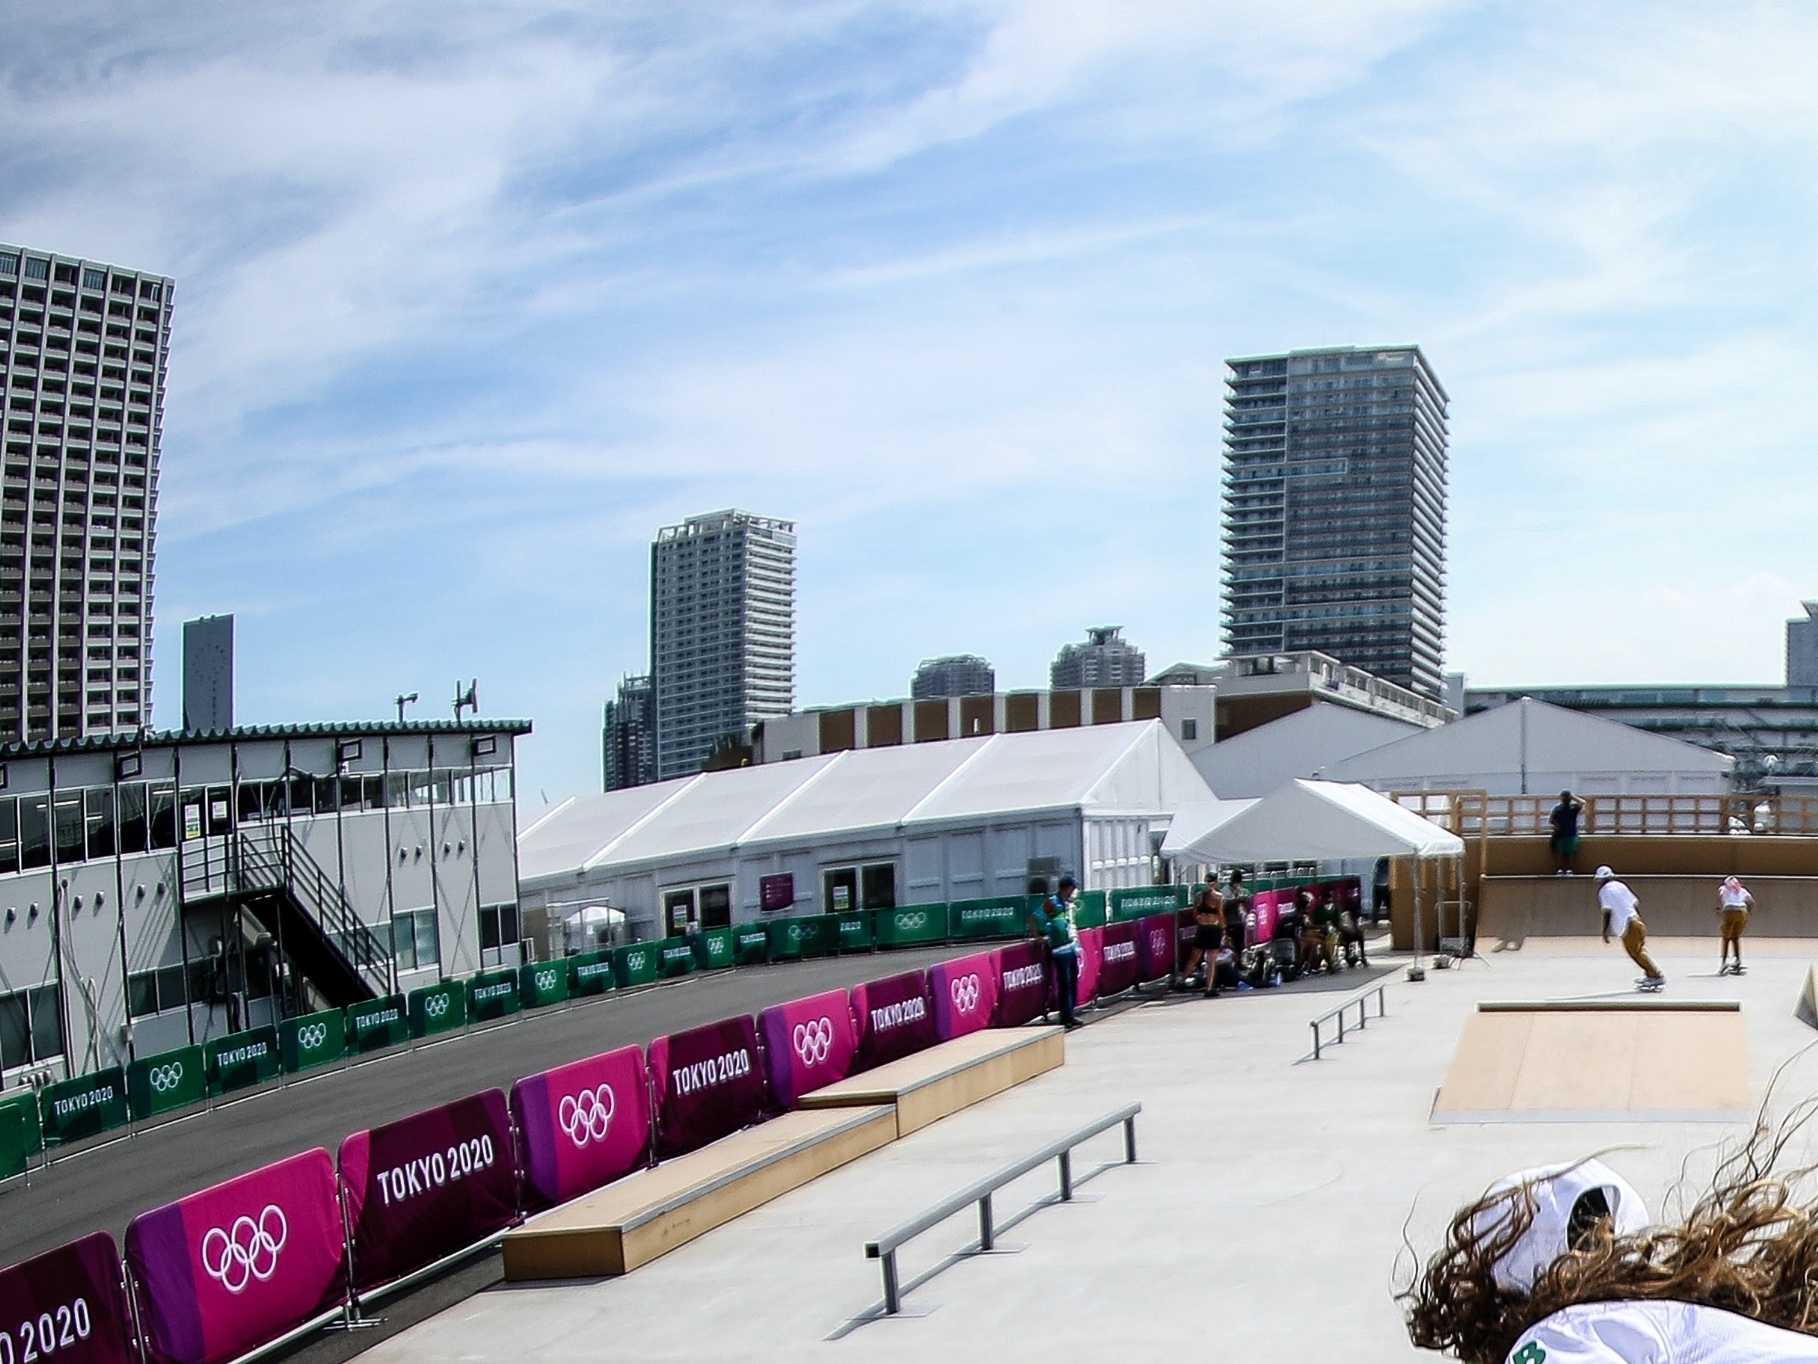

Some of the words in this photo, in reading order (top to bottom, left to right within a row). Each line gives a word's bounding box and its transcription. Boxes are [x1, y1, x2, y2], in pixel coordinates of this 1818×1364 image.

[355, 1012, 379, 1029] TOKYO
[871, 1001, 902, 1031] TOKYO
[217, 1048, 245, 1067] TOKYO
[246, 1041, 267, 1058] 2020
[672, 1058, 717, 1096] TOKYO
[717, 1048, 750, 1081] 2020
[55, 1095, 87, 1116] TOKYO
[89, 1085, 113, 1106] 2020
[376, 1152, 445, 1205] TOKYO
[447, 1134, 493, 1179] 2020
[20, 1297, 91, 1364] 2020
